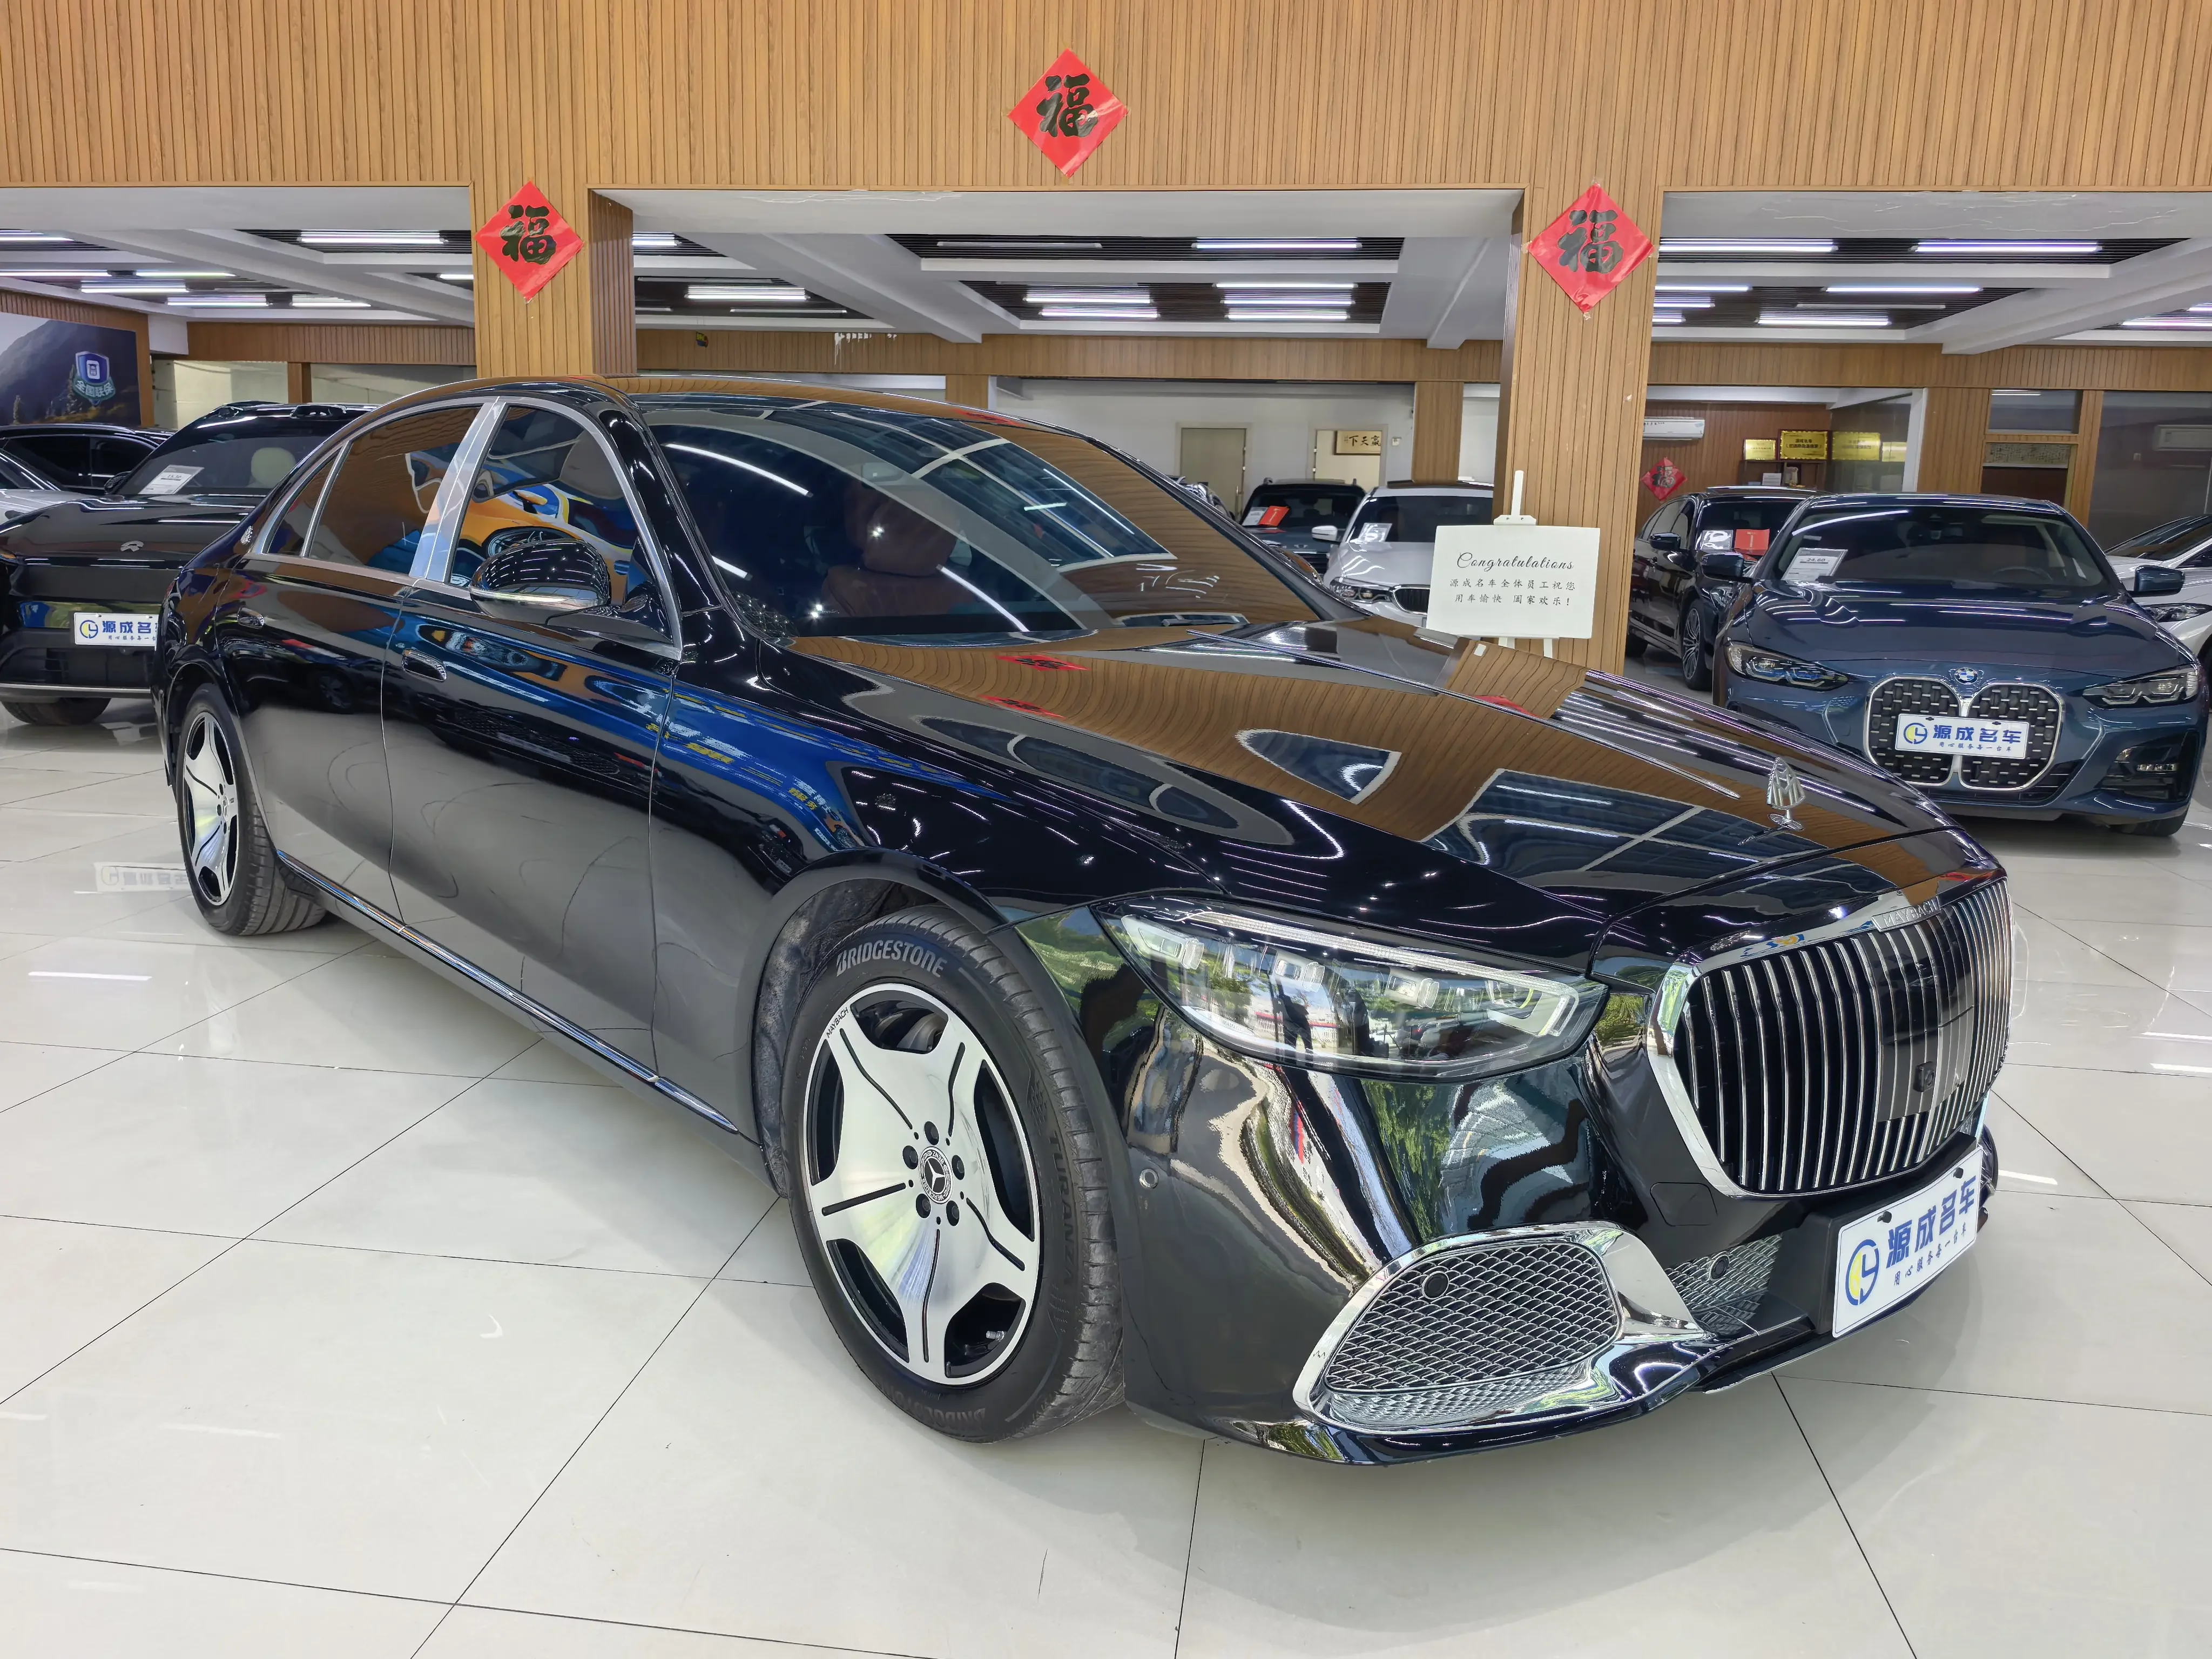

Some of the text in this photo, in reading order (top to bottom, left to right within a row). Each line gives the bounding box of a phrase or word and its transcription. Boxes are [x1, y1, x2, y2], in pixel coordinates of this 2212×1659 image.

[1036, 73, 1098, 137] 福
[500, 205, 557, 265] 福
[1557, 210, 1624, 274] 福
[75, 380, 114, 397] 全国联保
[1651, 466, 1676, 488] 福
[1456, 552, 1574, 572] Congratulations
[1450, 578, 1575, 591] 源成名车全体员工祝您
[1455, 594, 1502, 603] 用车愉快
[1933, 724, 2022, 744] 源成名车
[1883, 896, 1941, 927] MAYBACH
[836, 940, 948, 977] BRIDGESTONE
[826, 1007, 849, 1038] MAYBACH
[1886, 1175, 1977, 1269] 源成名车
[1893, 1222, 1967, 1286] 用心服务每一台车
